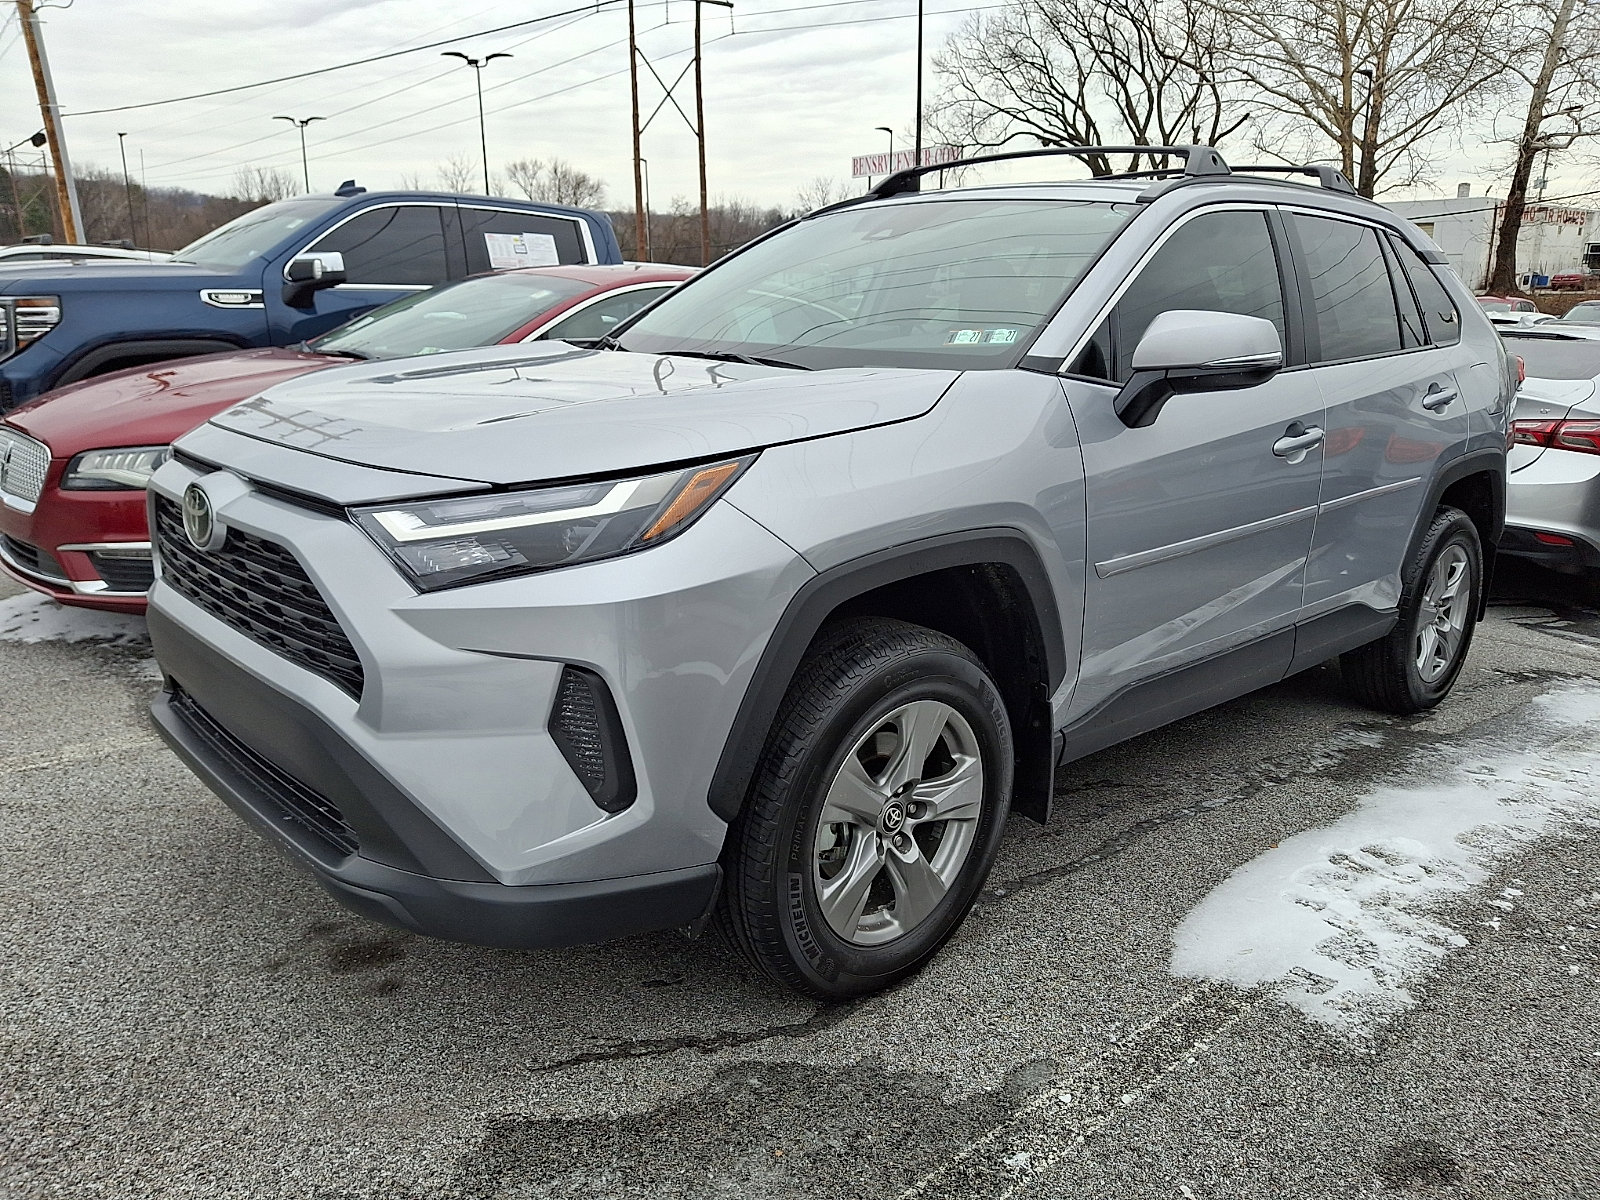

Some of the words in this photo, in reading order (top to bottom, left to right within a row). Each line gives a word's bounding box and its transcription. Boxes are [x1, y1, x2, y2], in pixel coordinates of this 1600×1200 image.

[969, 331, 980, 342] 27
[1005, 330, 1016, 342] 27
[790, 877, 820, 961] MICHELIN
